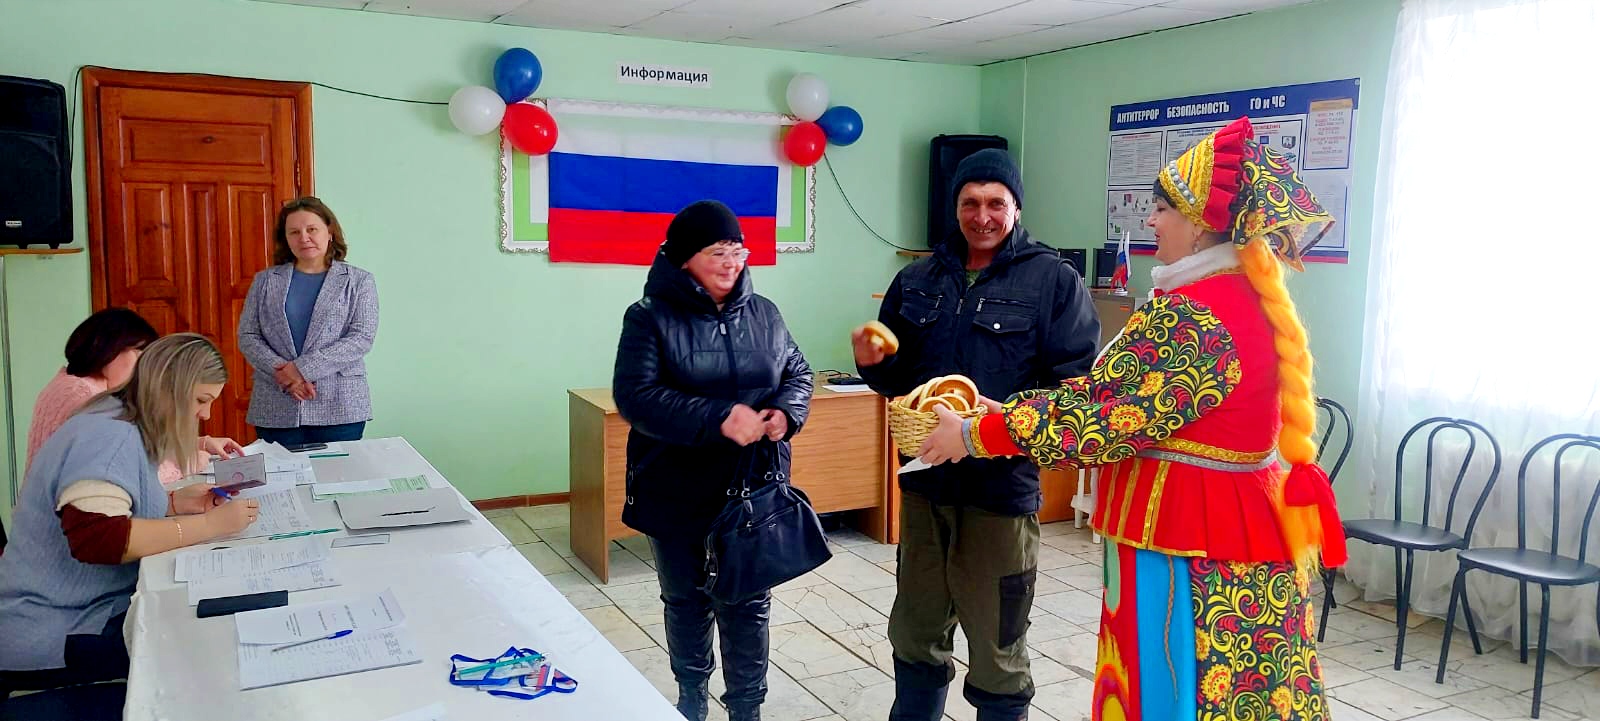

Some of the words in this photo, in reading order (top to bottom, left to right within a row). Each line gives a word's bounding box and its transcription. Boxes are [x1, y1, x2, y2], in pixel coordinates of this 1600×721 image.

[620, 65, 708, 84] Информация
[1116, 108, 1160, 123] АНТИТЕРРОР
[1166, 101, 1230, 118] БЕЗОПАСНОСТЬ
[1250, 97, 1262, 110] ГО
[1263, 99, 1270, 109] и
[1272, 95, 1286, 108] ЧС
